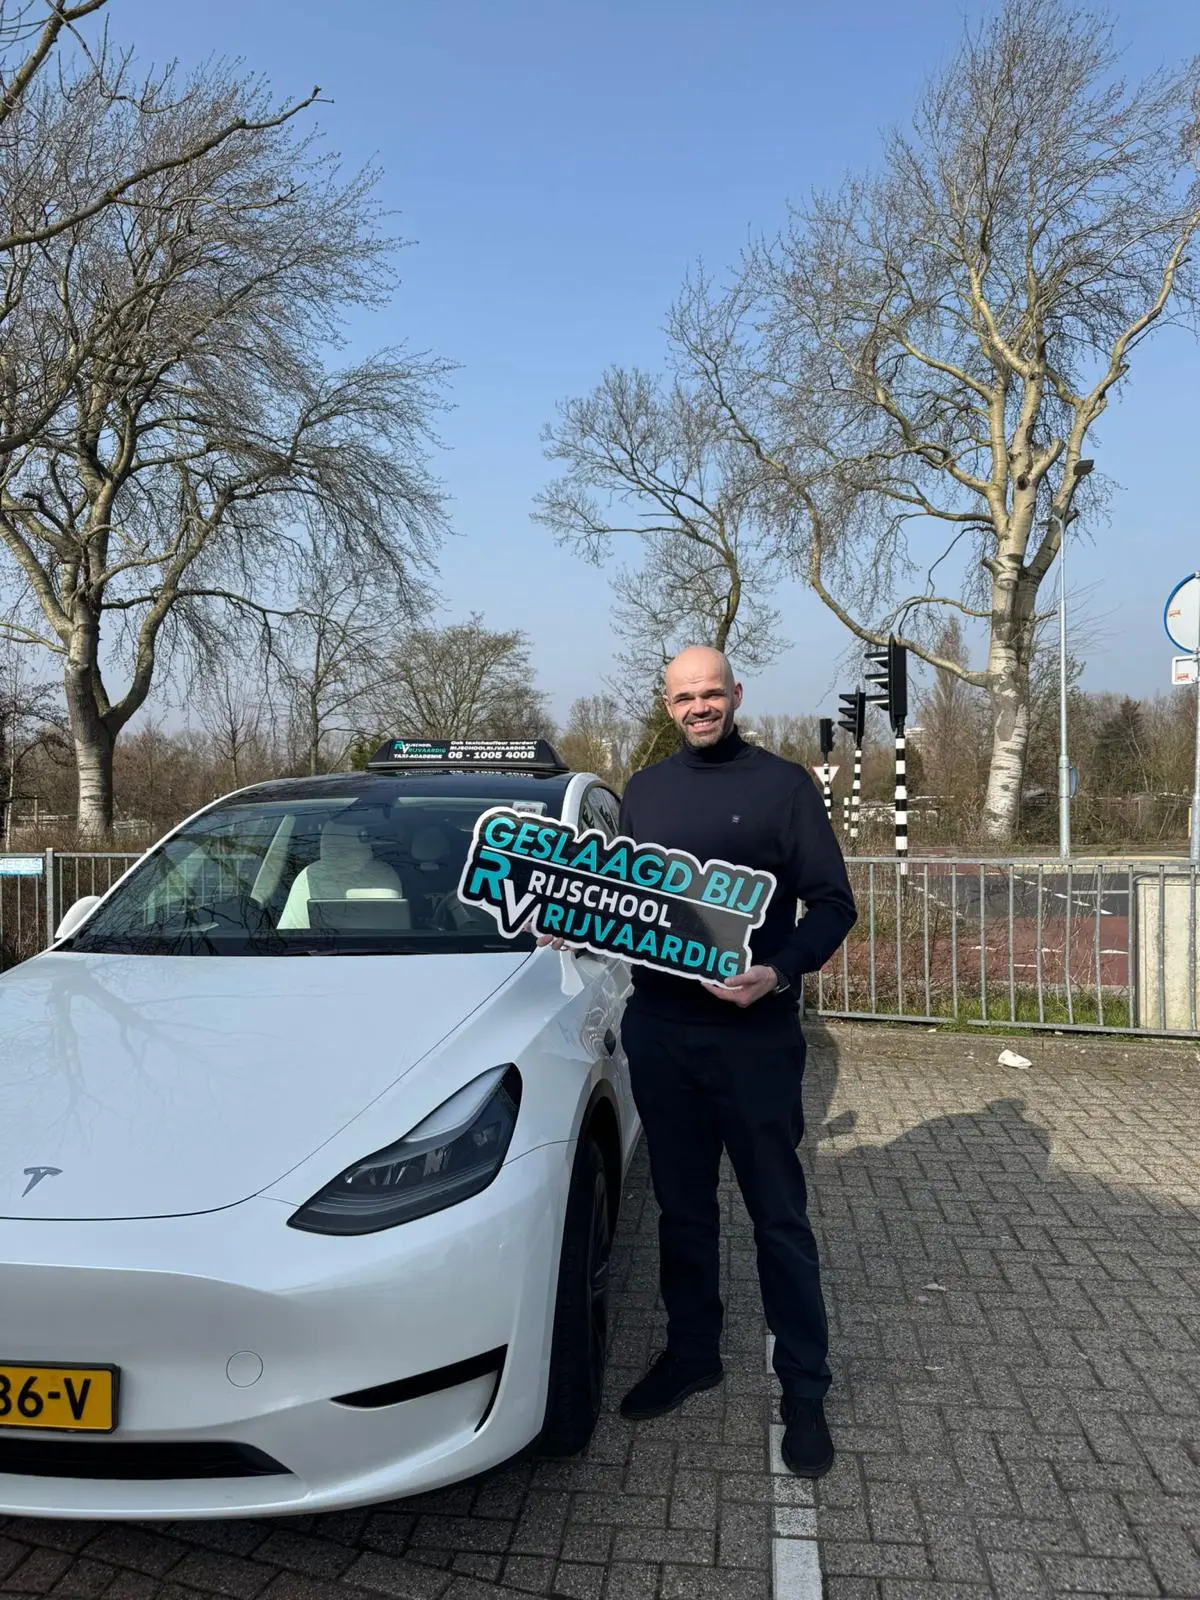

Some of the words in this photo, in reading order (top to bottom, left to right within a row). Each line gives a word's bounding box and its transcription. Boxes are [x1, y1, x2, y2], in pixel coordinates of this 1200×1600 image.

[448, 751, 463, 759] 06
[473, 751, 502, 759] 1005
[505, 751, 535, 759] 4008
[484, 817, 693, 894] GESLAAGD
[701, 870, 765, 913] BIJ
[527, 870, 672, 928] RIJSCHOOL
[543, 902, 740, 978] RIJVAARDIG
